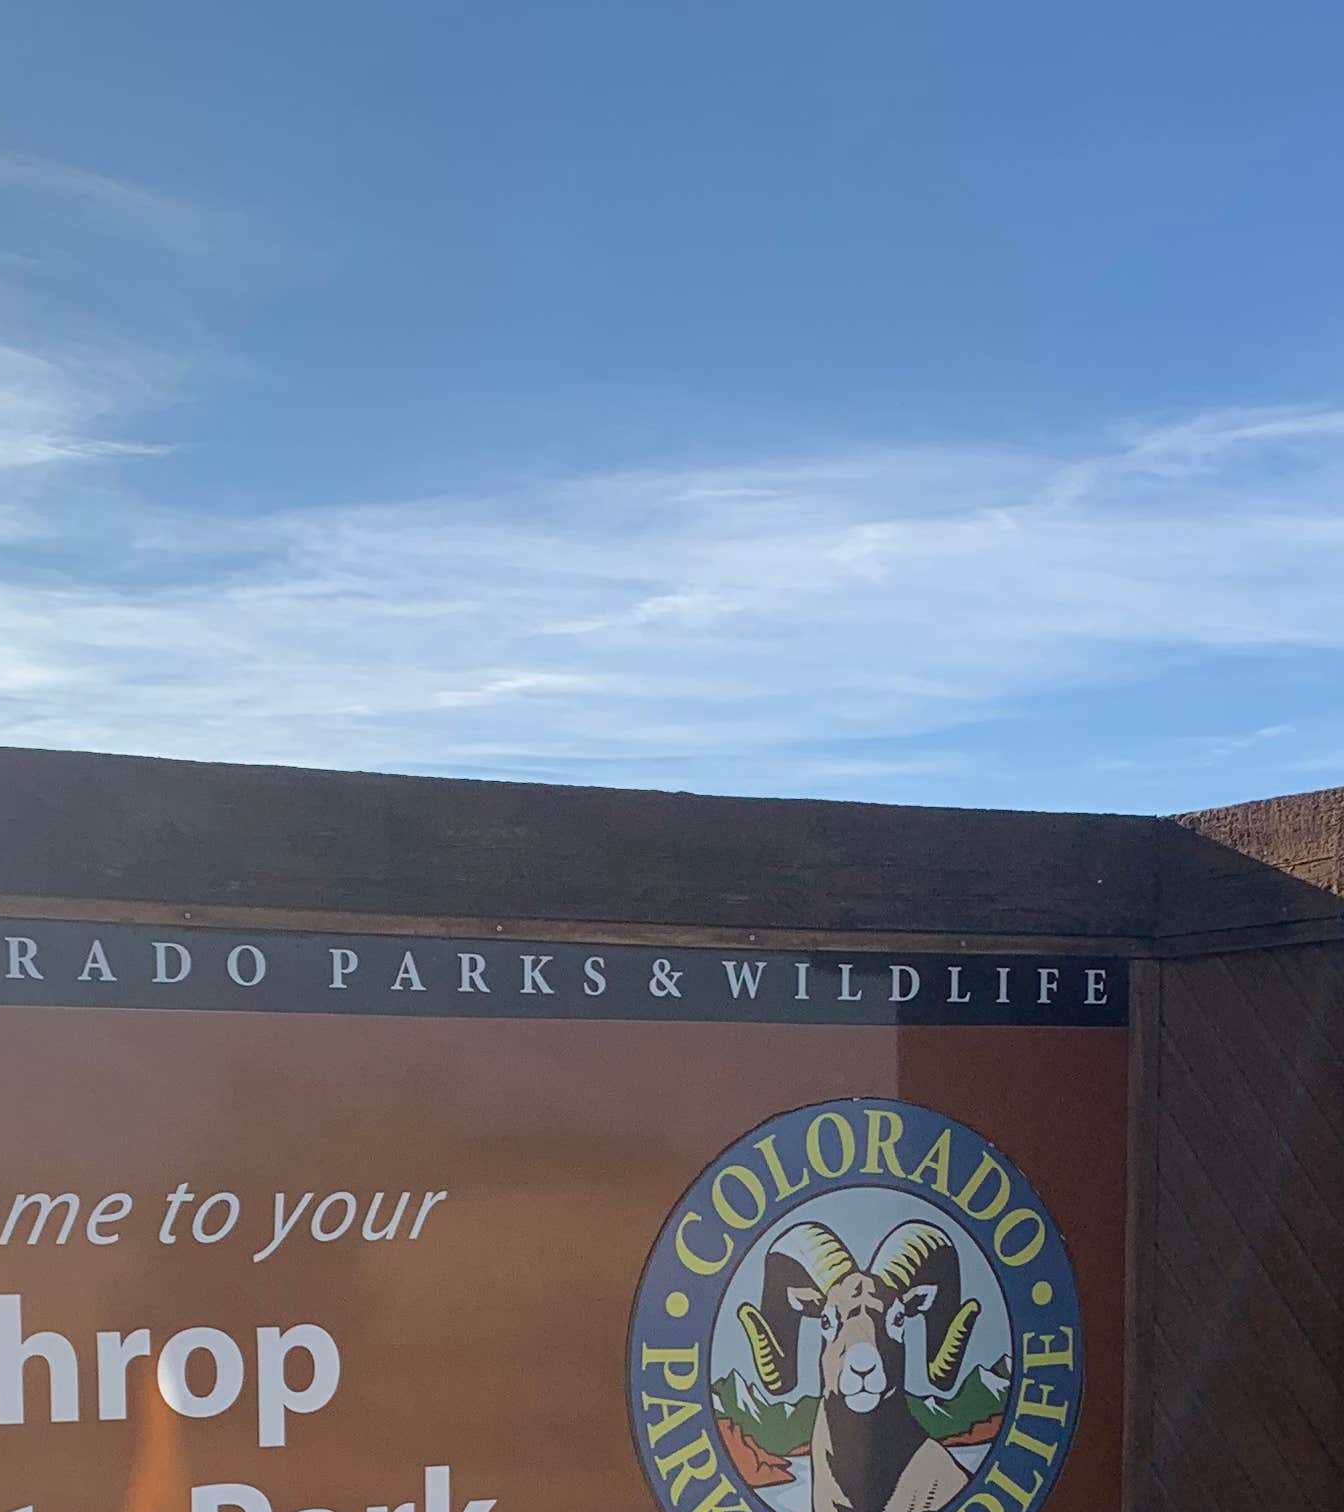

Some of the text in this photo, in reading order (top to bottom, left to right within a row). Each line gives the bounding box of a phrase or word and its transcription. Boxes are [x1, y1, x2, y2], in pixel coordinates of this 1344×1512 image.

[329, 947, 607, 998] PARKS
[649, 958, 683, 999] &
[722, 960, 1109, 1006] WILDLIFE
[158, 1182, 241, 1245] to
[253, 1187, 448, 1263] your
[674, 1108, 1047, 1276] COLORADO
